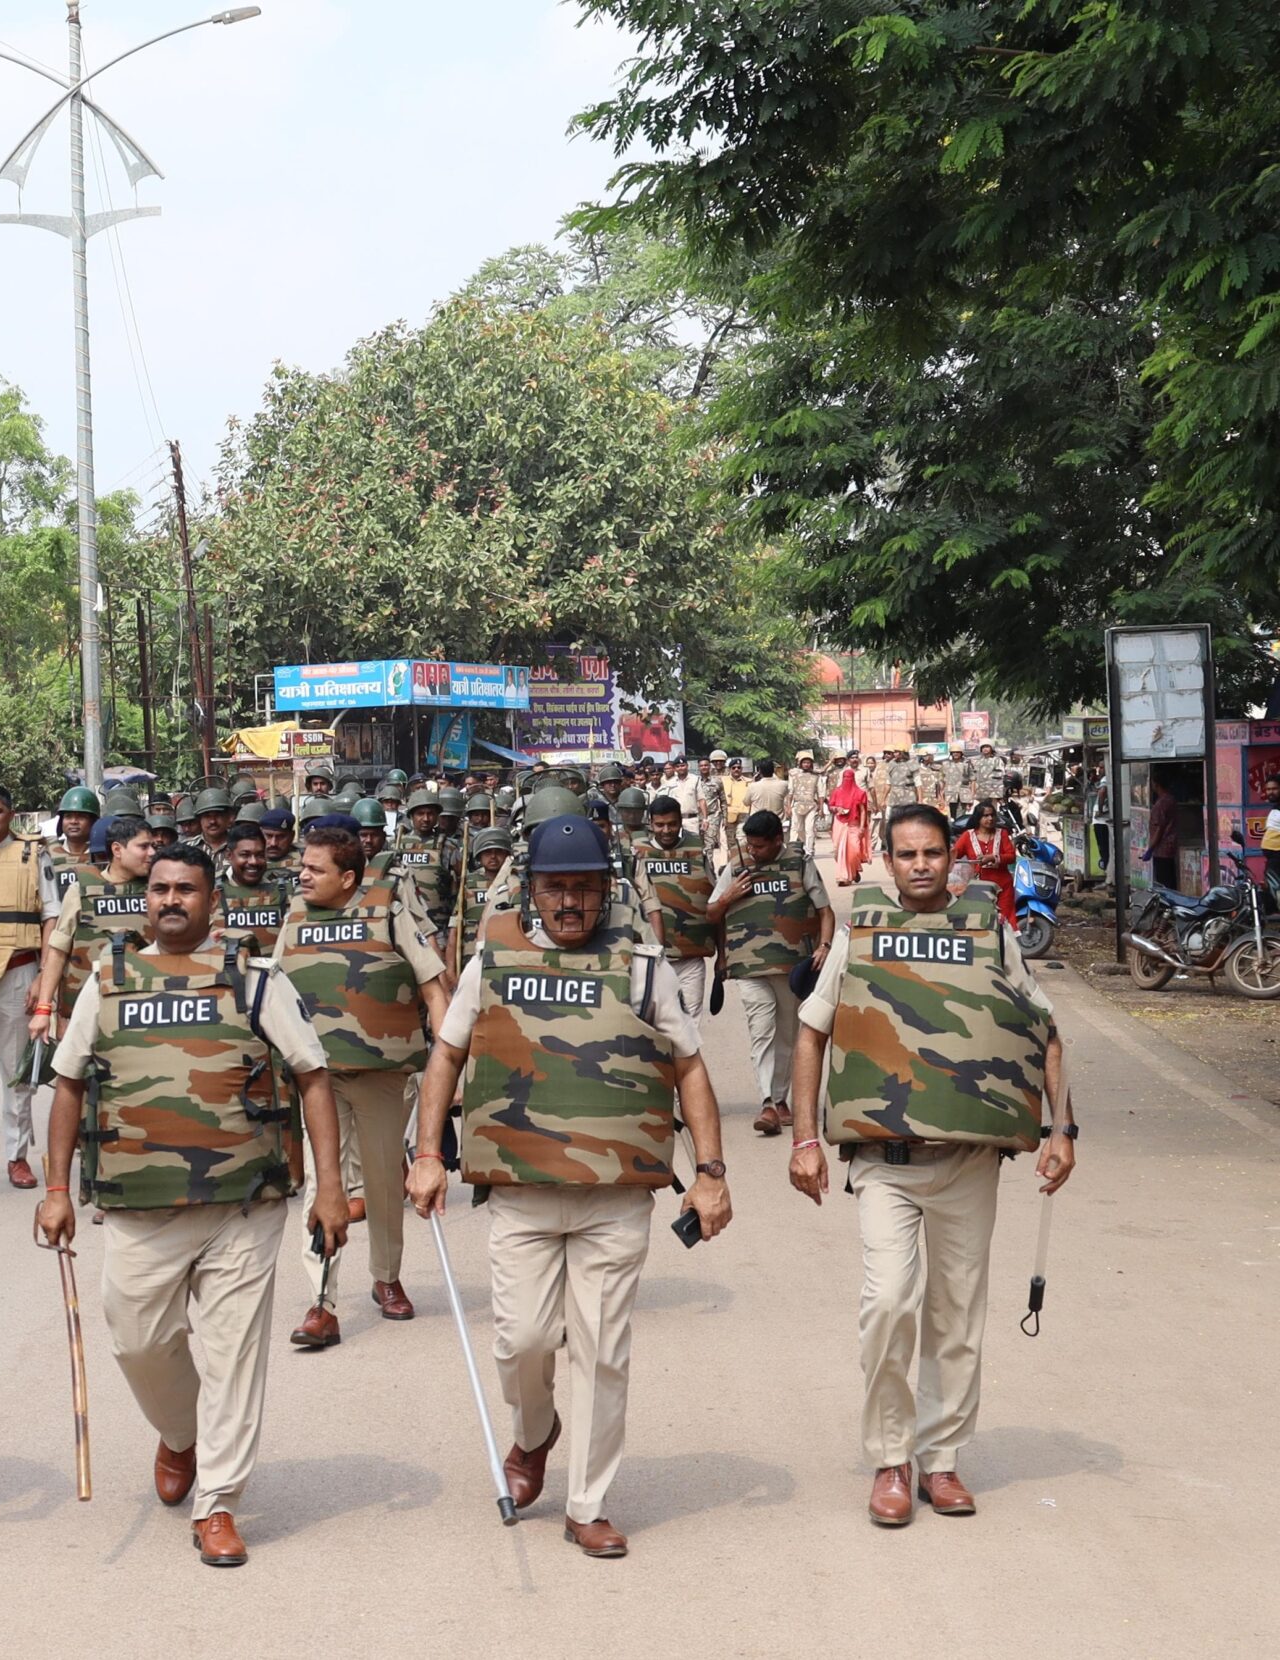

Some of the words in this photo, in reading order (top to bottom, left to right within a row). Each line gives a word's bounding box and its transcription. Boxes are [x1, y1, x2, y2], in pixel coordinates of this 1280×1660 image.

[278, 681, 310, 698] यात्री
[314, 680, 382, 698] प्रतिक्षालय
[452, 676, 469, 695] यात्री
[471, 677, 504, 697] प्रतिक्षालय
[402, 853, 429, 863] OLICE
[647, 862, 688, 874] POLICE
[753, 880, 788, 894] OLICE
[97, 898, 149, 914] POLICE
[227, 912, 277, 926] POLICE
[301, 923, 363, 945] POLICE
[878, 935, 967, 962] POLICE
[507, 978, 597, 1004] POLICE
[124, 999, 211, 1026] POLICE
